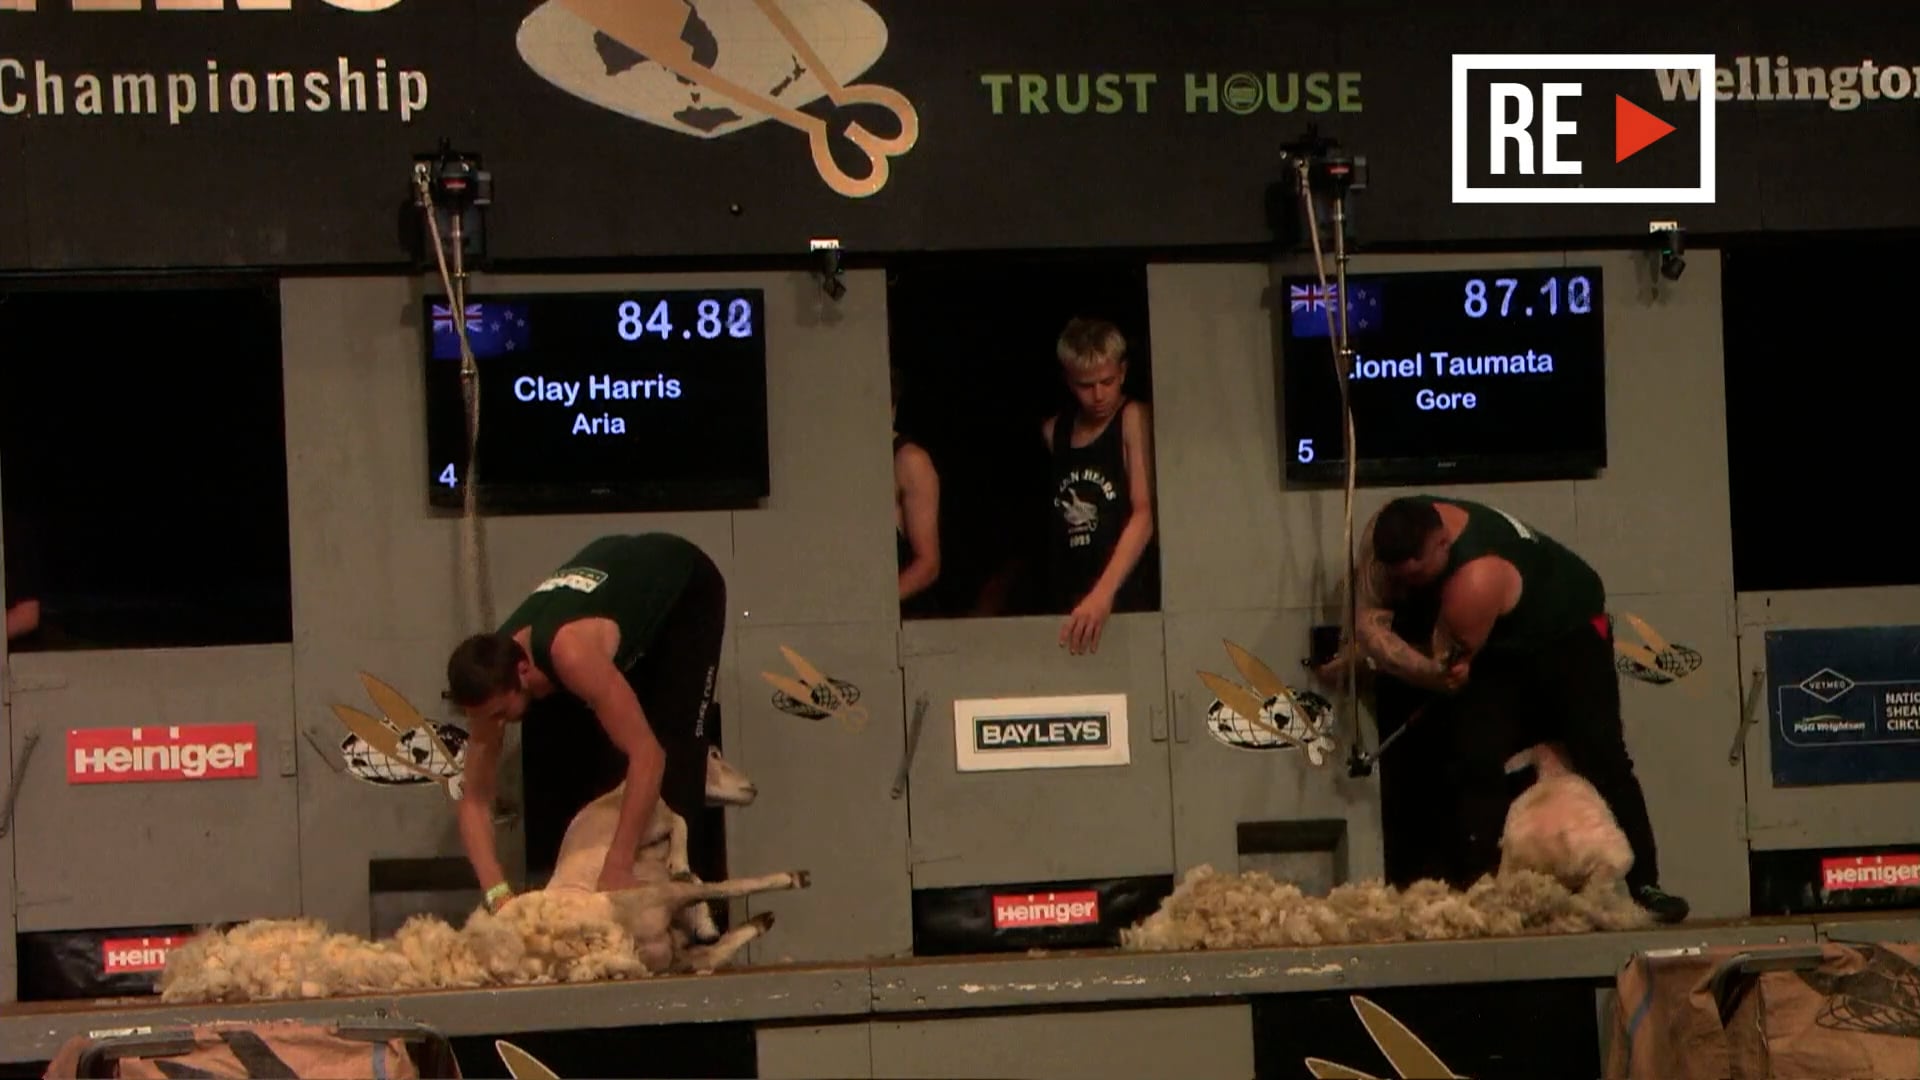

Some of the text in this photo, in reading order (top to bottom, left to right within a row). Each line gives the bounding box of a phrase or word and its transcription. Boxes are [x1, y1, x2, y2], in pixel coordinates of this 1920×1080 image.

[0, 56, 429, 125] Championship
[981, 71, 1363, 115] TRUST HOUSE
[1430, 350, 1553, 376] Taumata
[514, 374, 682, 406] Clay Harris
[1416, 389, 1476, 410] Gore
[572, 413, 626, 435] Aria
[1298, 439, 1314, 463] 5
[439, 463, 458, 488] 4
[1886, 705, 1920, 717] SHEA
[982, 720, 1101, 745] BAYLEYS
[74, 726, 253, 777] Heiniger
[997, 893, 1095, 923] Heiniger
